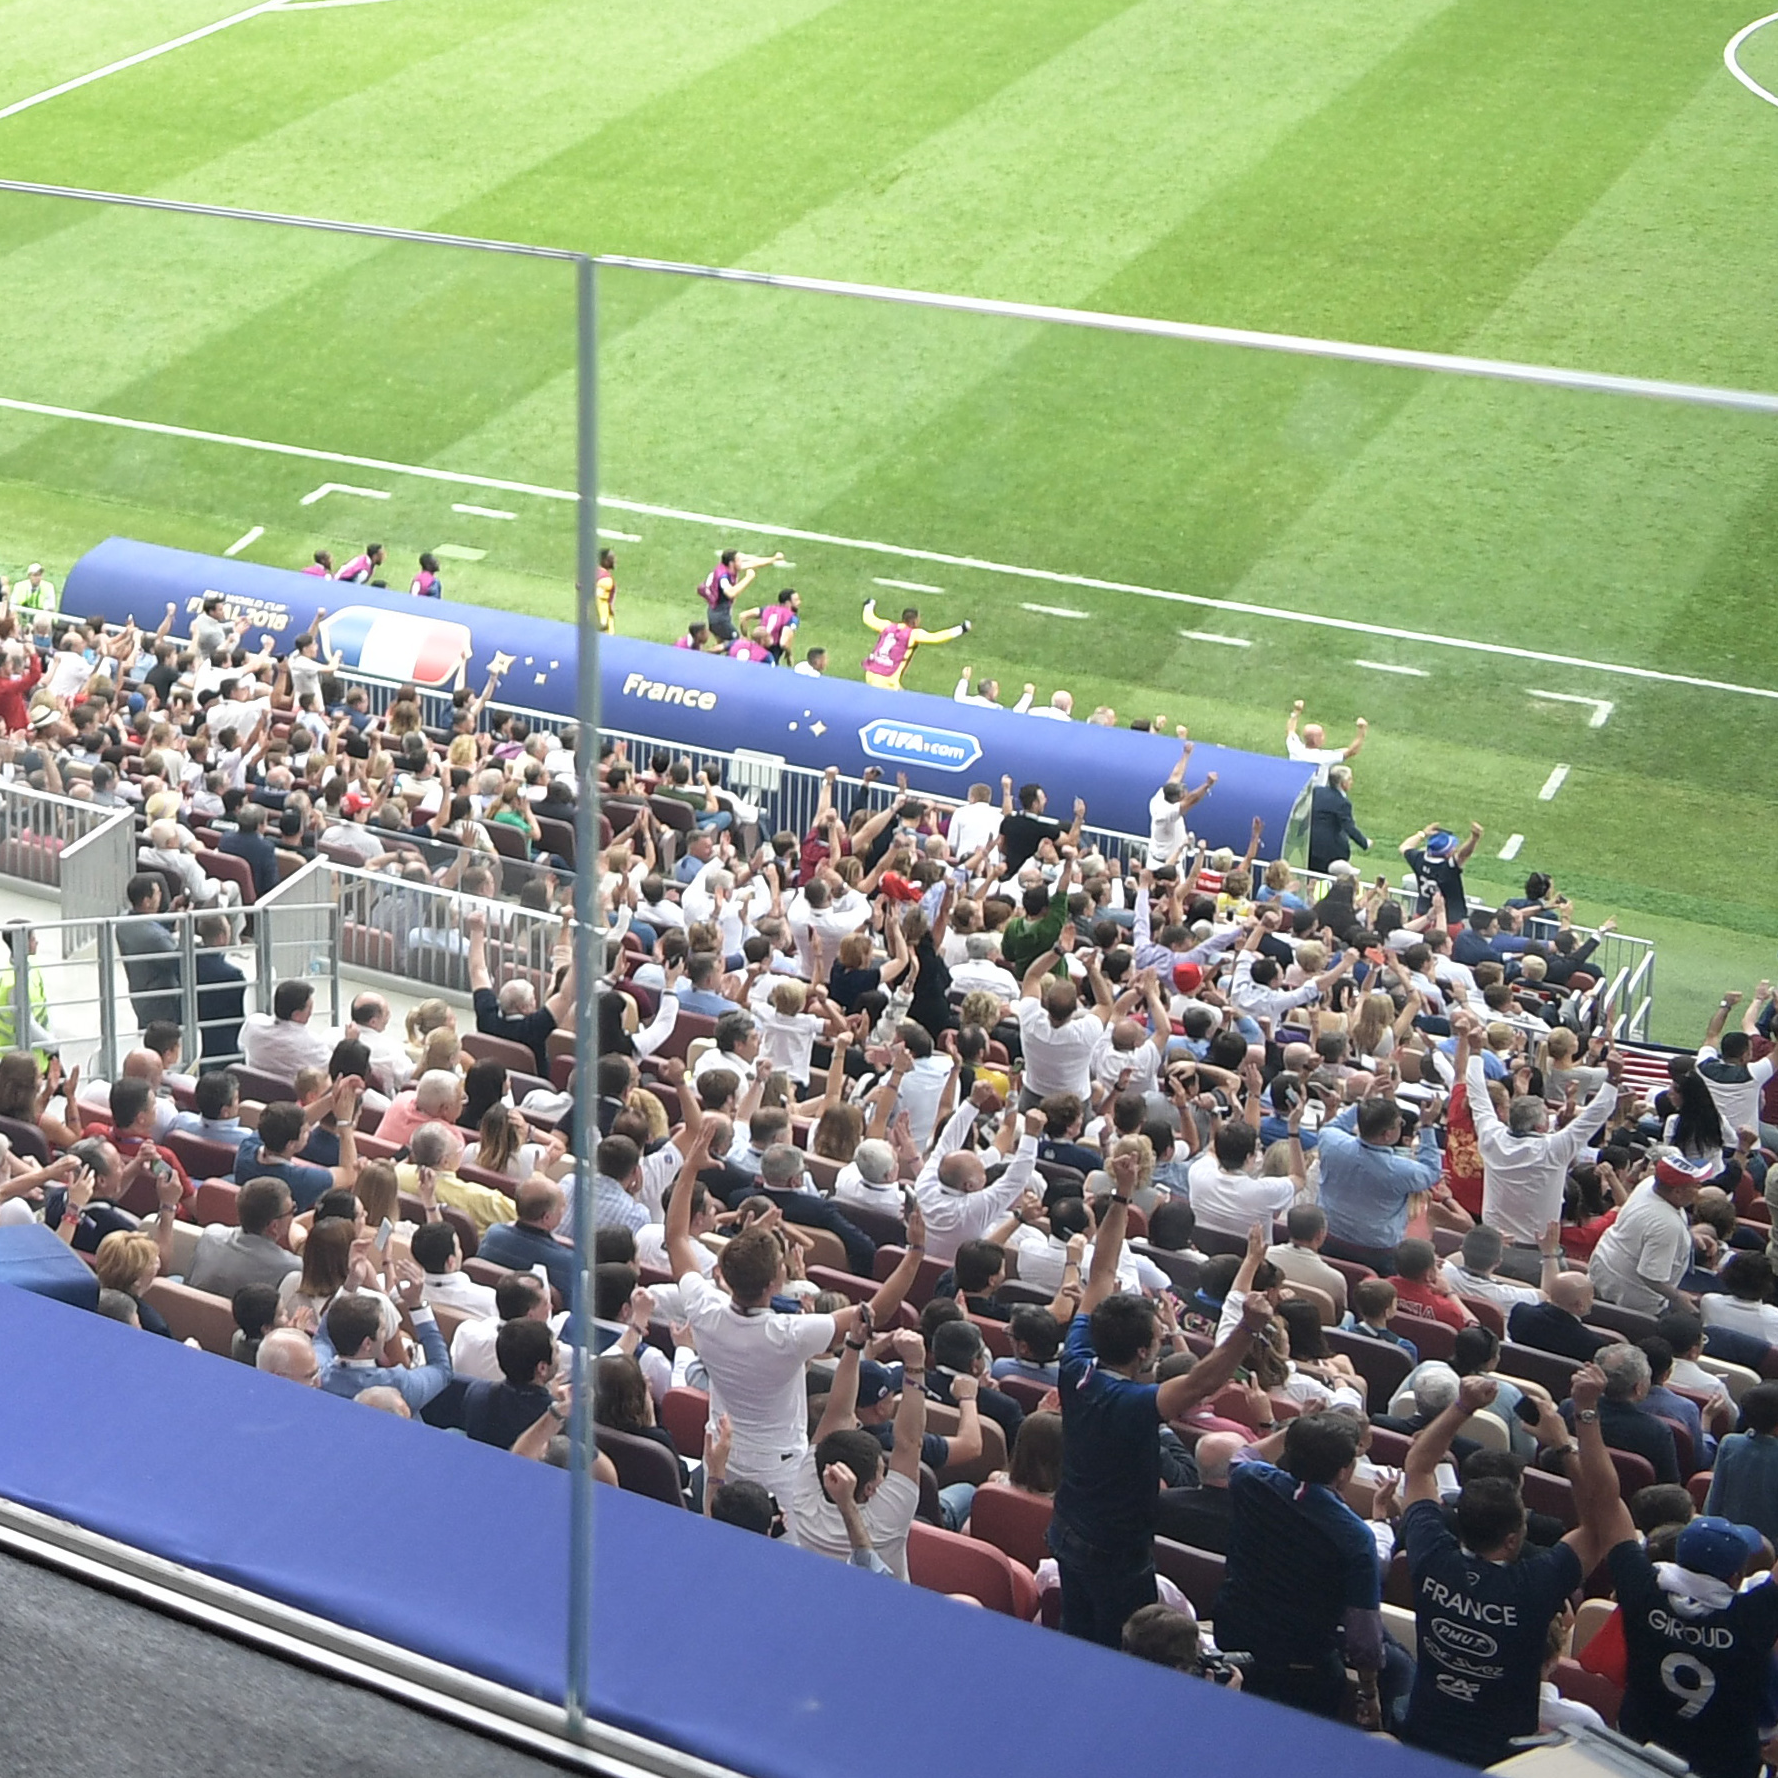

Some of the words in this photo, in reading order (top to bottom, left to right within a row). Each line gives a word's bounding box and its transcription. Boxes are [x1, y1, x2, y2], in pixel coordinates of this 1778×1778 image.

[186, 596, 241, 623] FIAL
[622, 672, 718, 711] France
[873, 727, 965, 760] FIFA.com
[1421, 1576, 1518, 1627] FRANCE
[1438, 1624, 1475, 1646] PMU
[1647, 1608, 1734, 1650] GIROUD
[1659, 1652, 1717, 1719] 9
